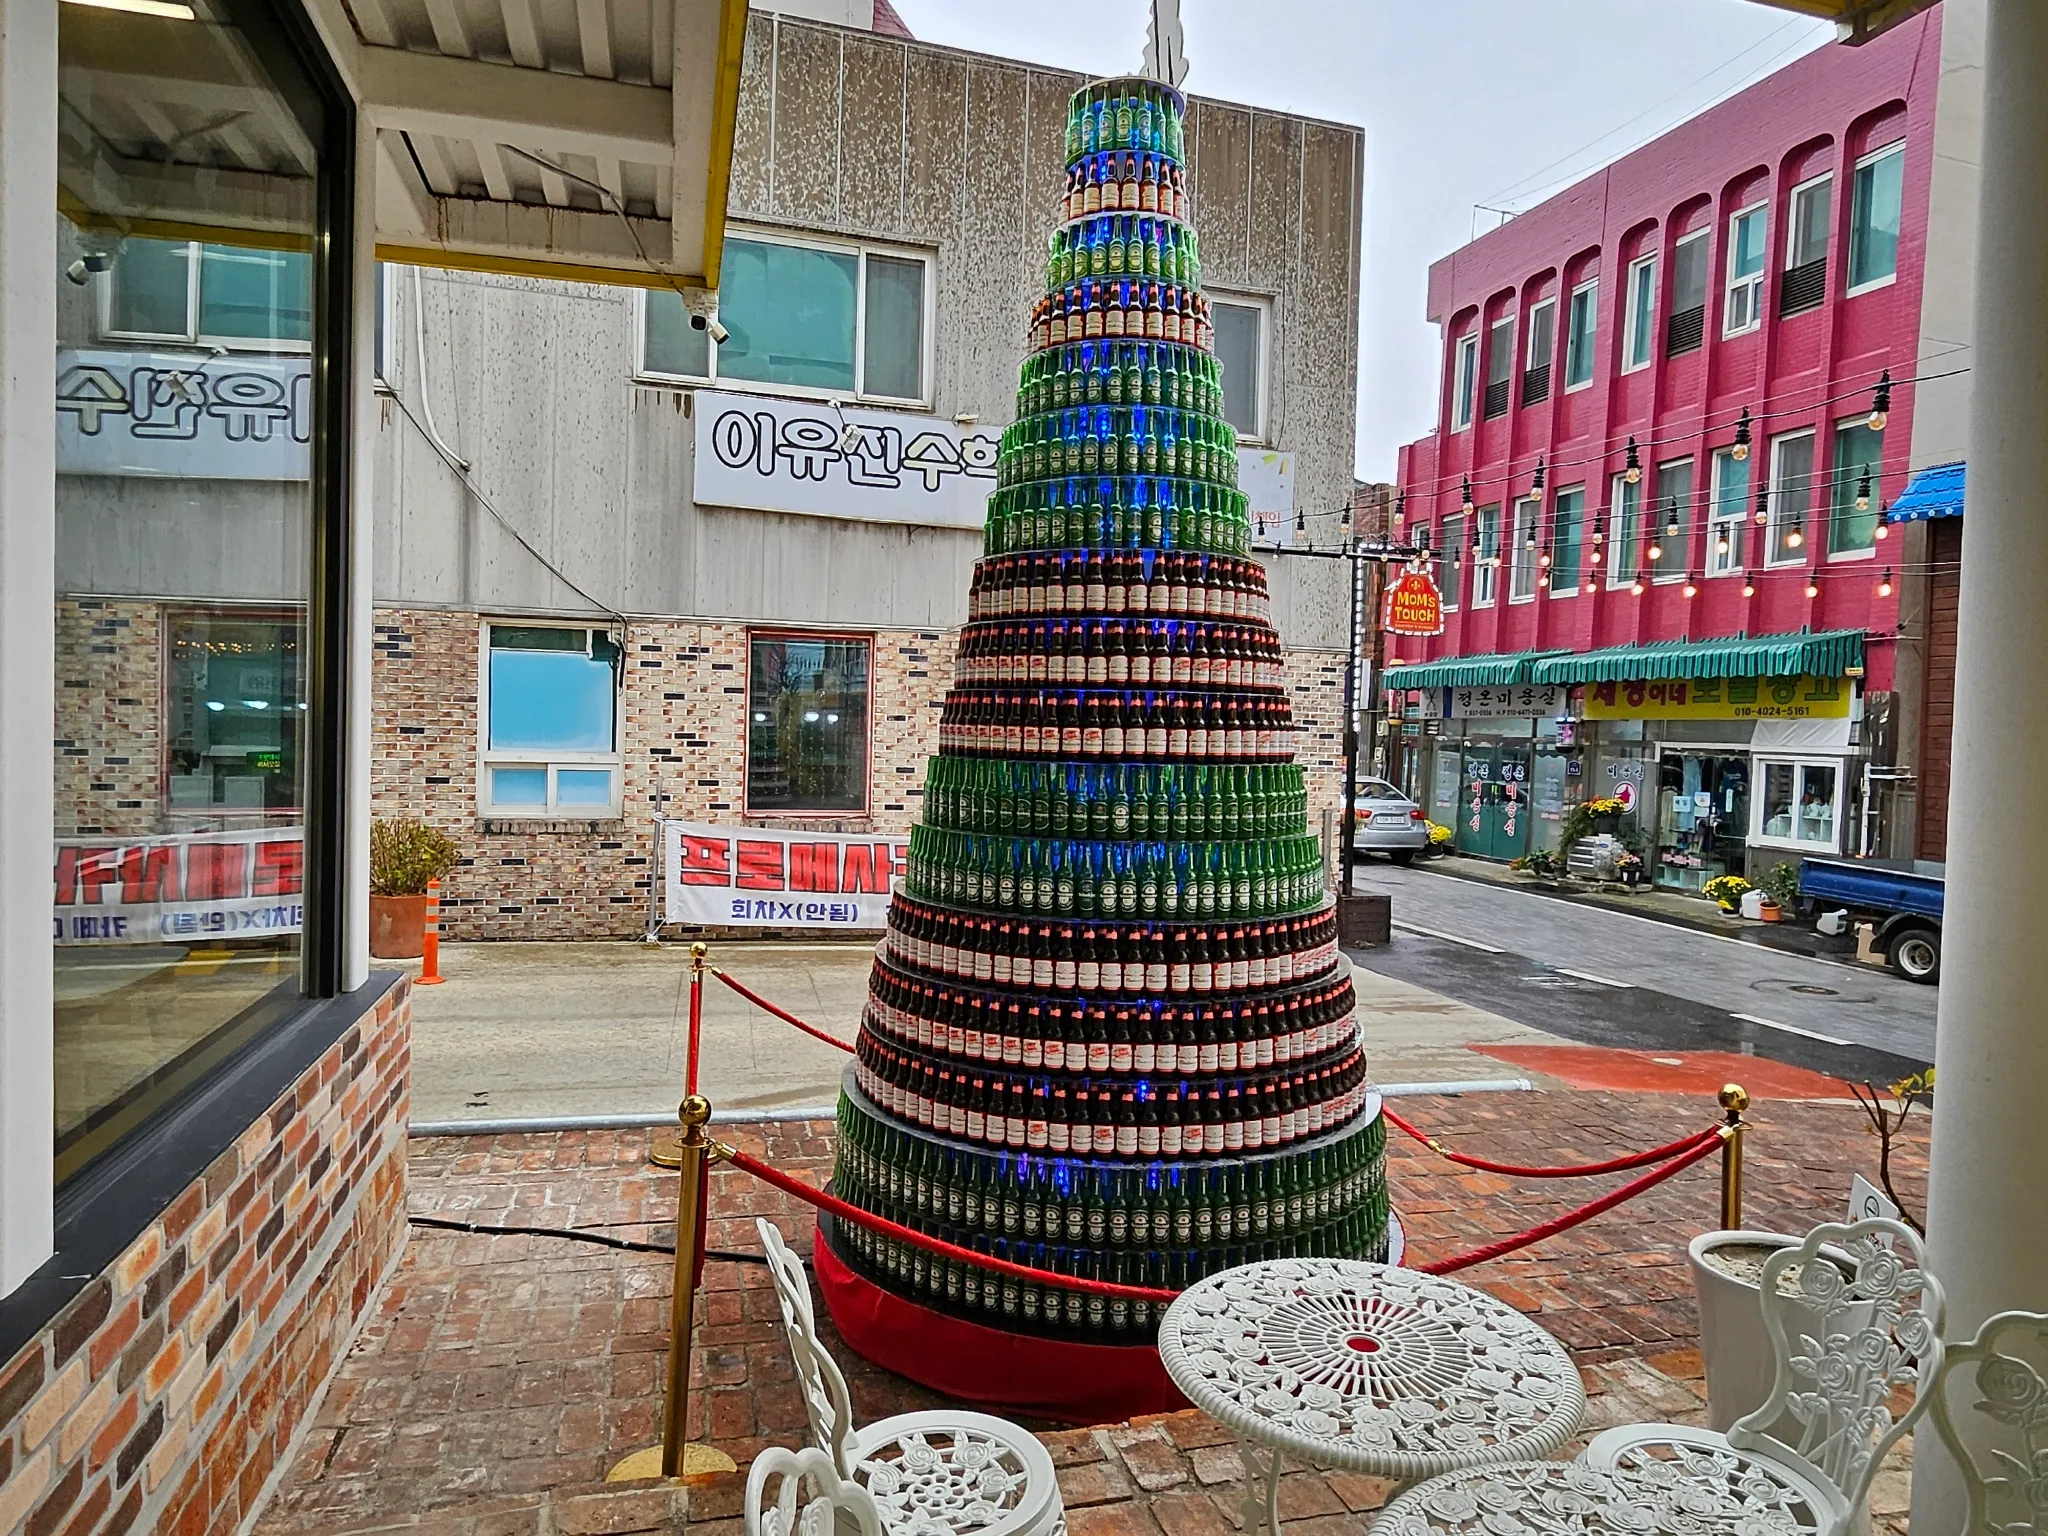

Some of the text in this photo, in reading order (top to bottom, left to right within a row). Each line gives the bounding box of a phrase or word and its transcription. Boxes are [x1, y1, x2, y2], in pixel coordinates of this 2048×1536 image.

[1395, 607, 1435, 622] TOUCH
[1734, 706, 1810, 717] 010-4024-5161
[680, 834, 907, 895] 프로메사
[731, 898, 859, 923] 회차X(안됨)
